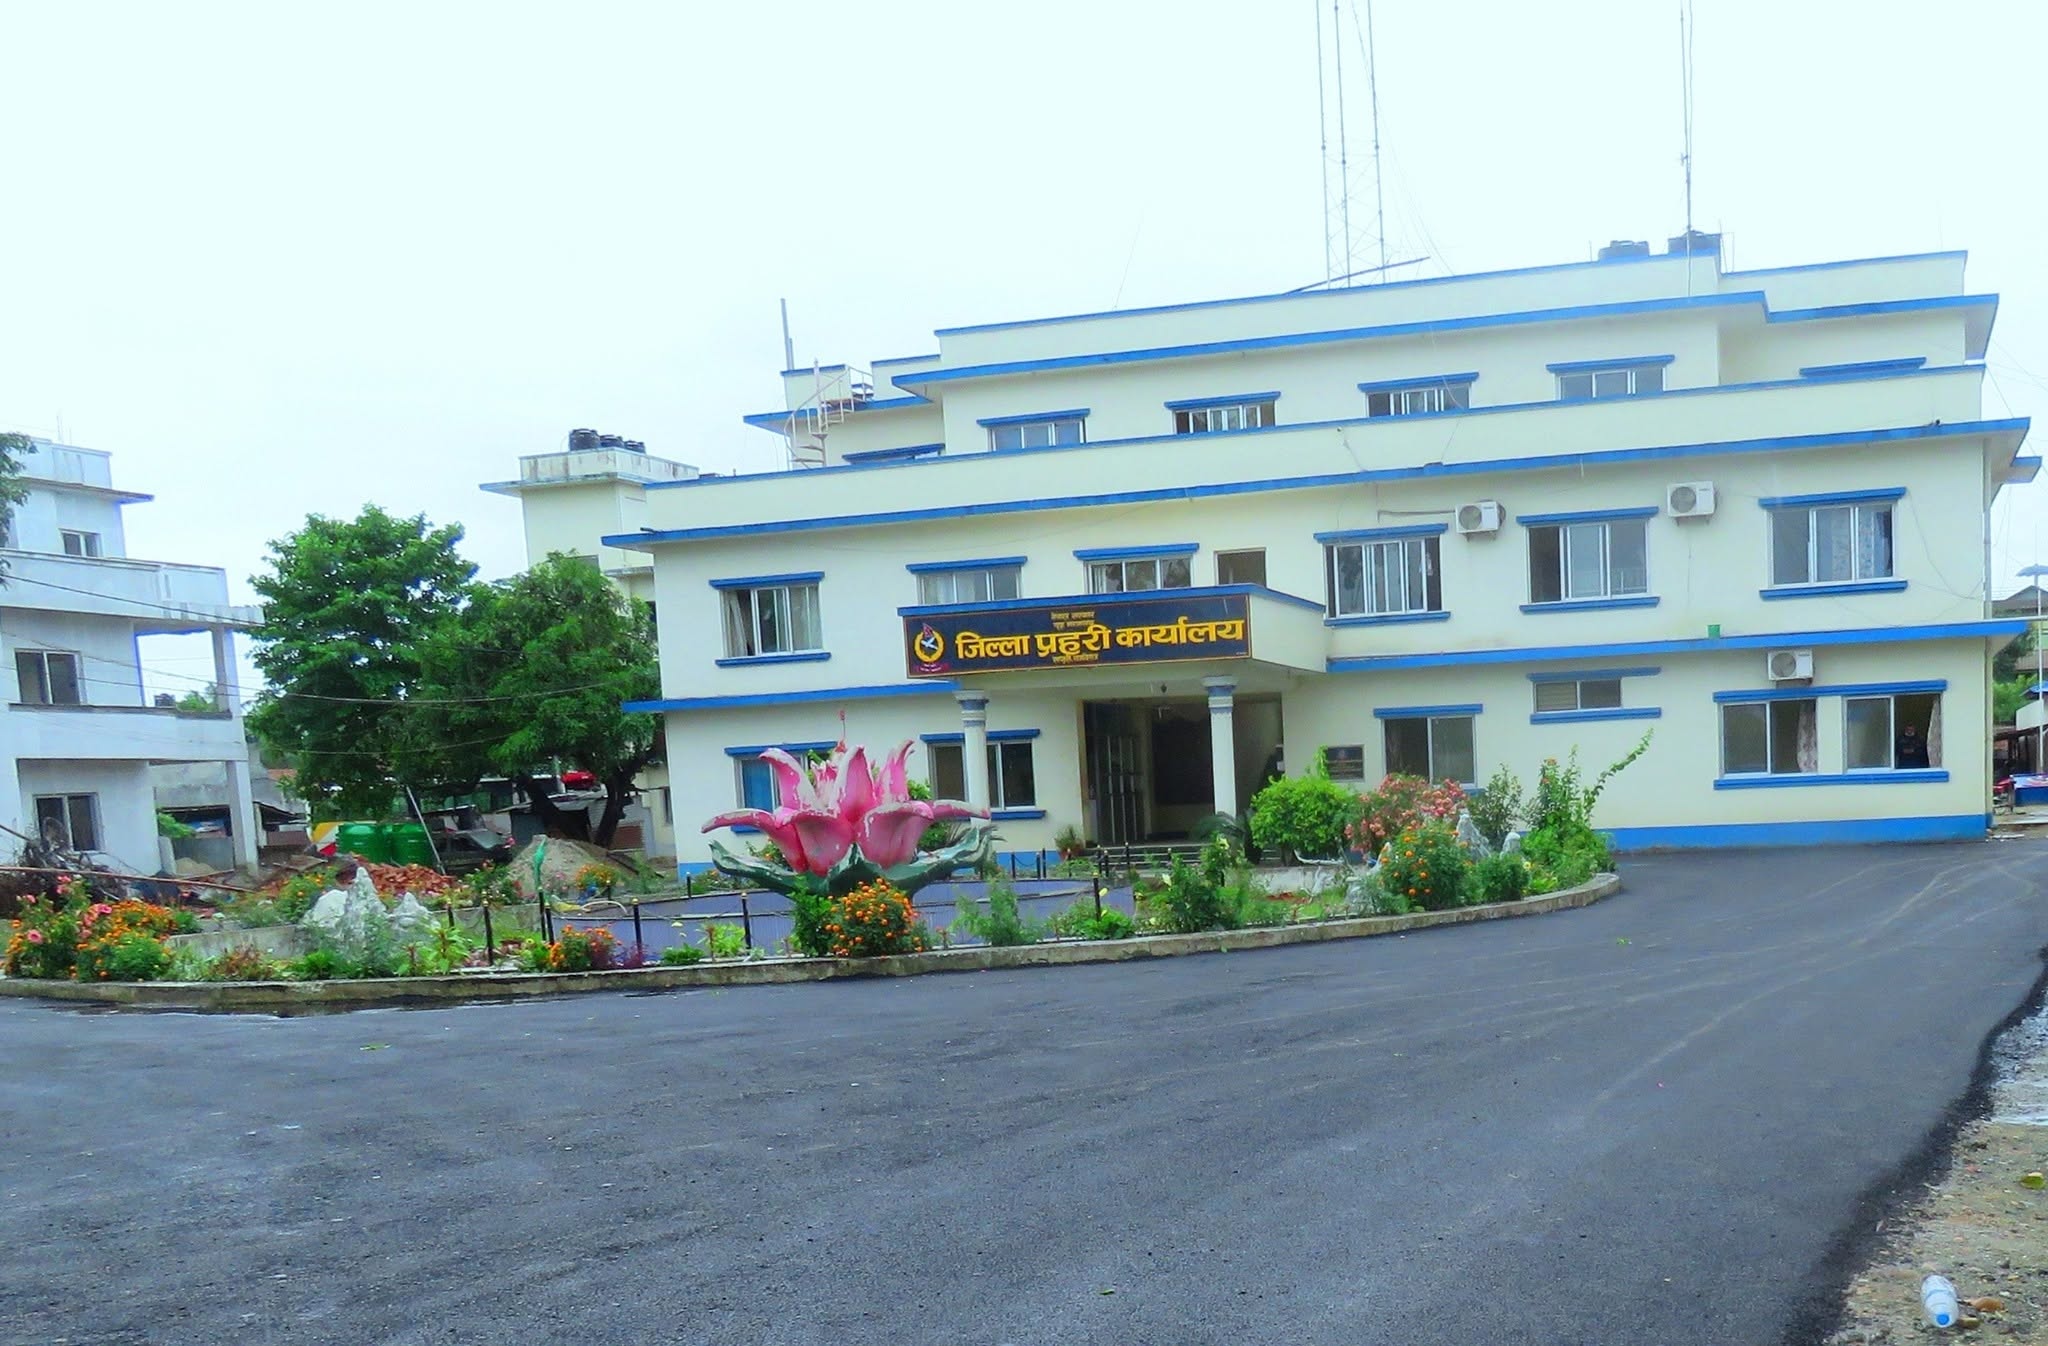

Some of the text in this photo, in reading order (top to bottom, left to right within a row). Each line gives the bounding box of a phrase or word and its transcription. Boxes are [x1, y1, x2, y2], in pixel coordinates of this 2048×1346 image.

[955, 616, 1245, 659] जिल्ला प्रहरी कार्यालय
